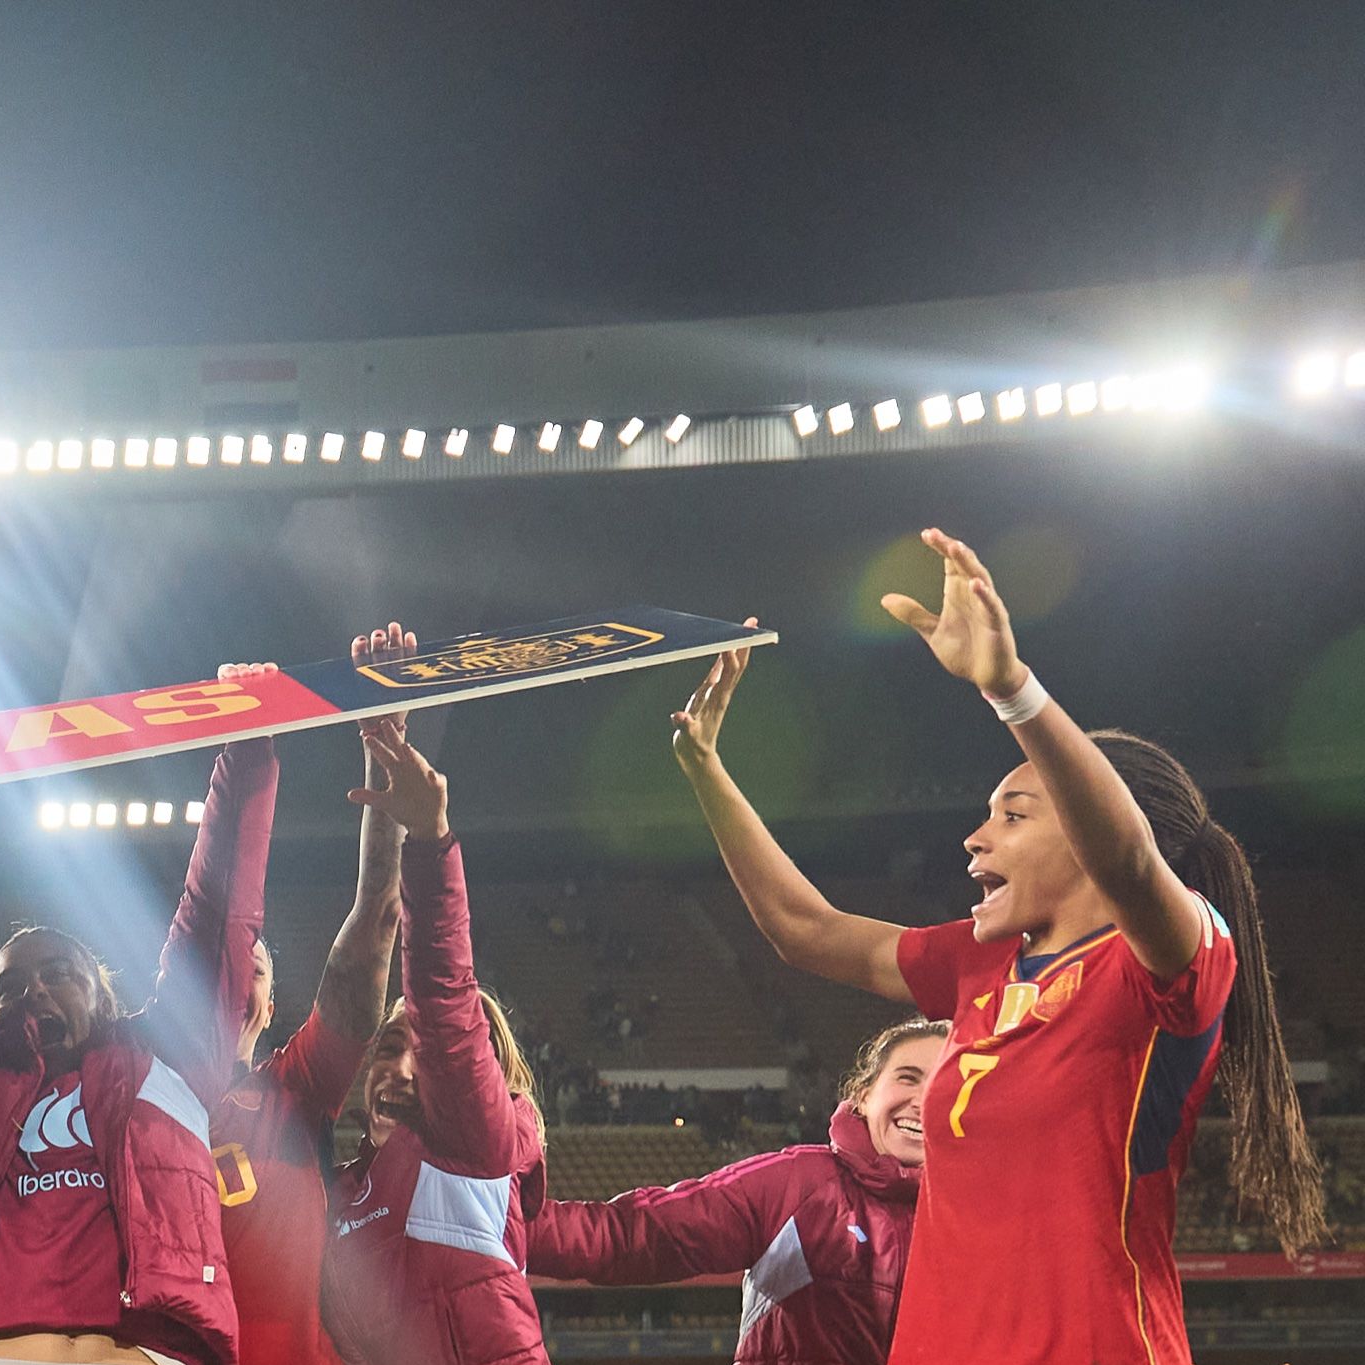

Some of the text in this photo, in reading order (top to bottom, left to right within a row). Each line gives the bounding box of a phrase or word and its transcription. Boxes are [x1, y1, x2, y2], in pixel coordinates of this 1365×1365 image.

[950, 1053, 1000, 1137] 7
[17, 1168, 105, 1197] Iberdro
[216, 1143, 257, 1207] 0
